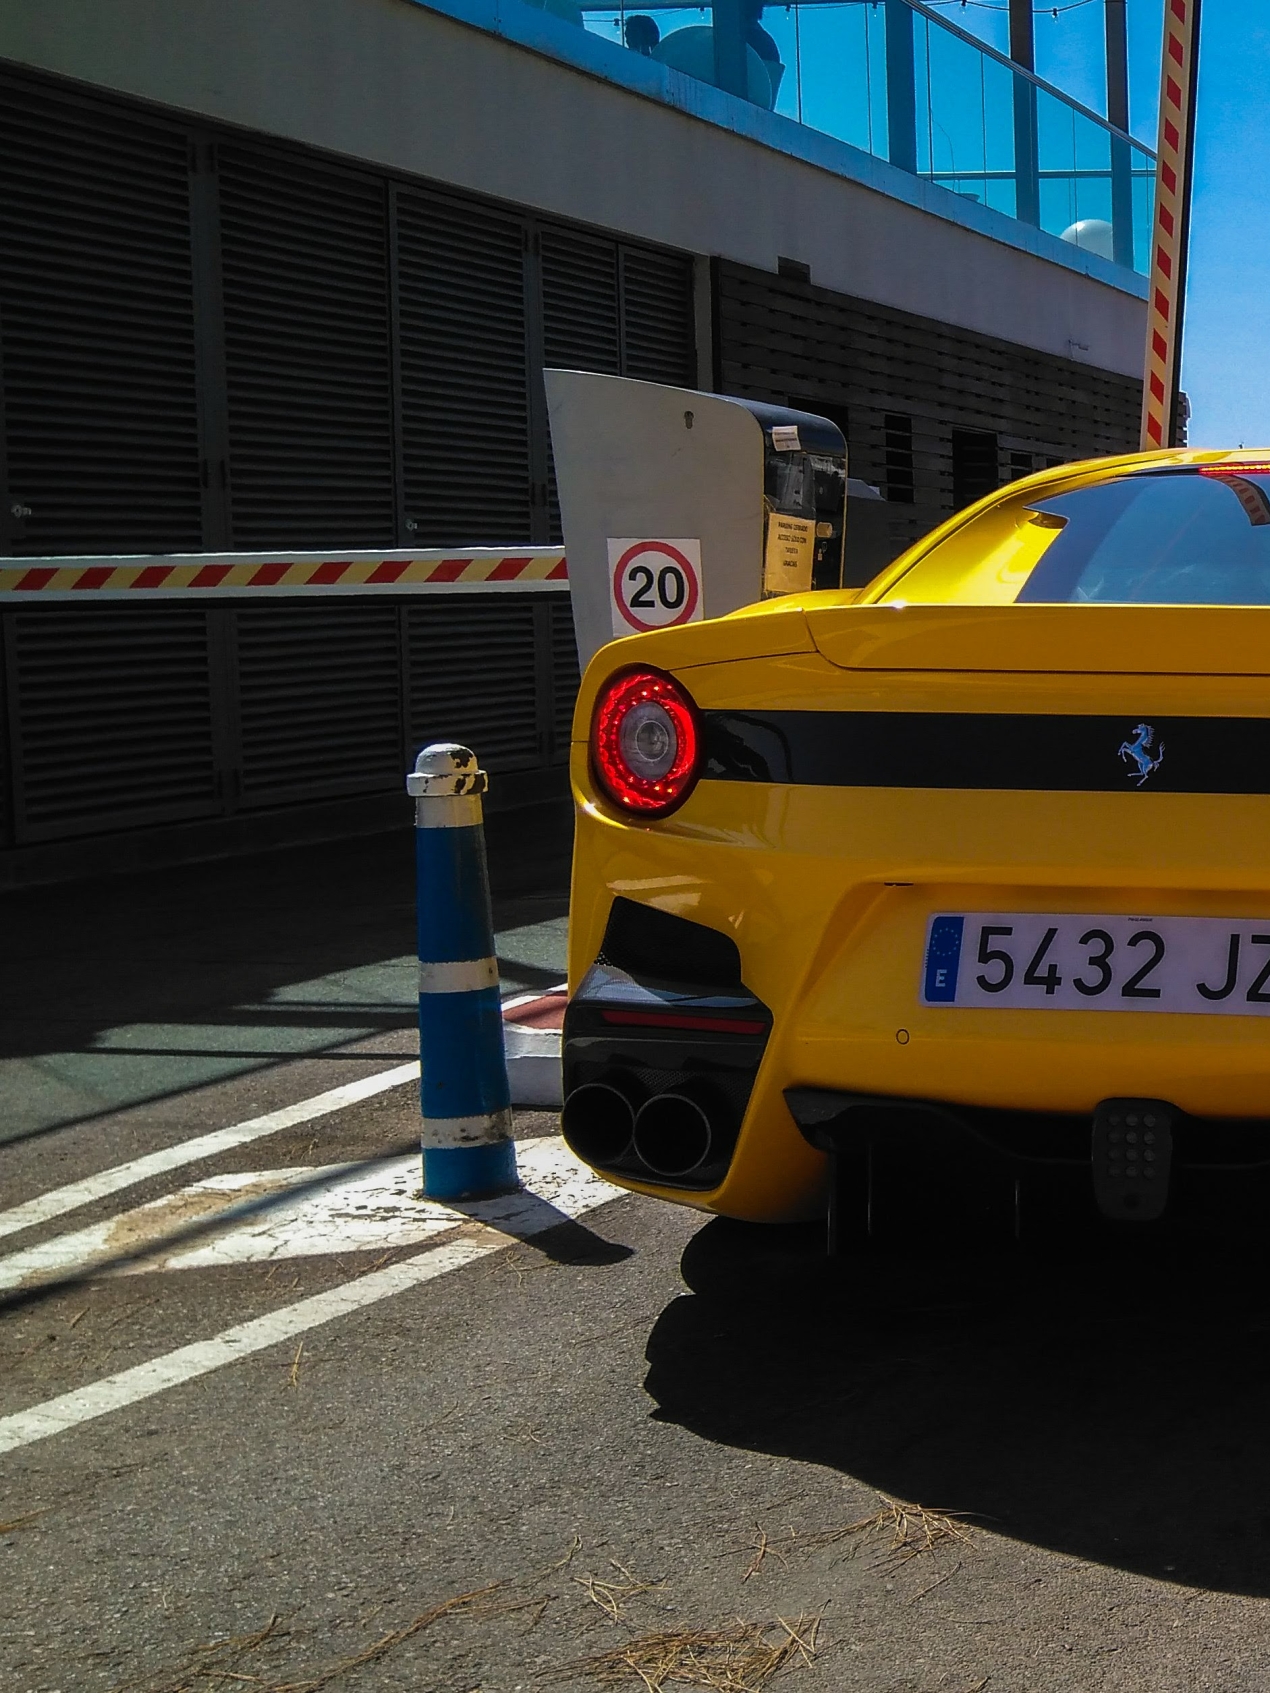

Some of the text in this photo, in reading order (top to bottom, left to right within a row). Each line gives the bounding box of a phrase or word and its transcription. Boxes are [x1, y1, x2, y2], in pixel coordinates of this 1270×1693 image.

[628, 565, 685, 609] 20
[935, 969, 947, 987] E
[976, 926, 1165, 998] 5432
